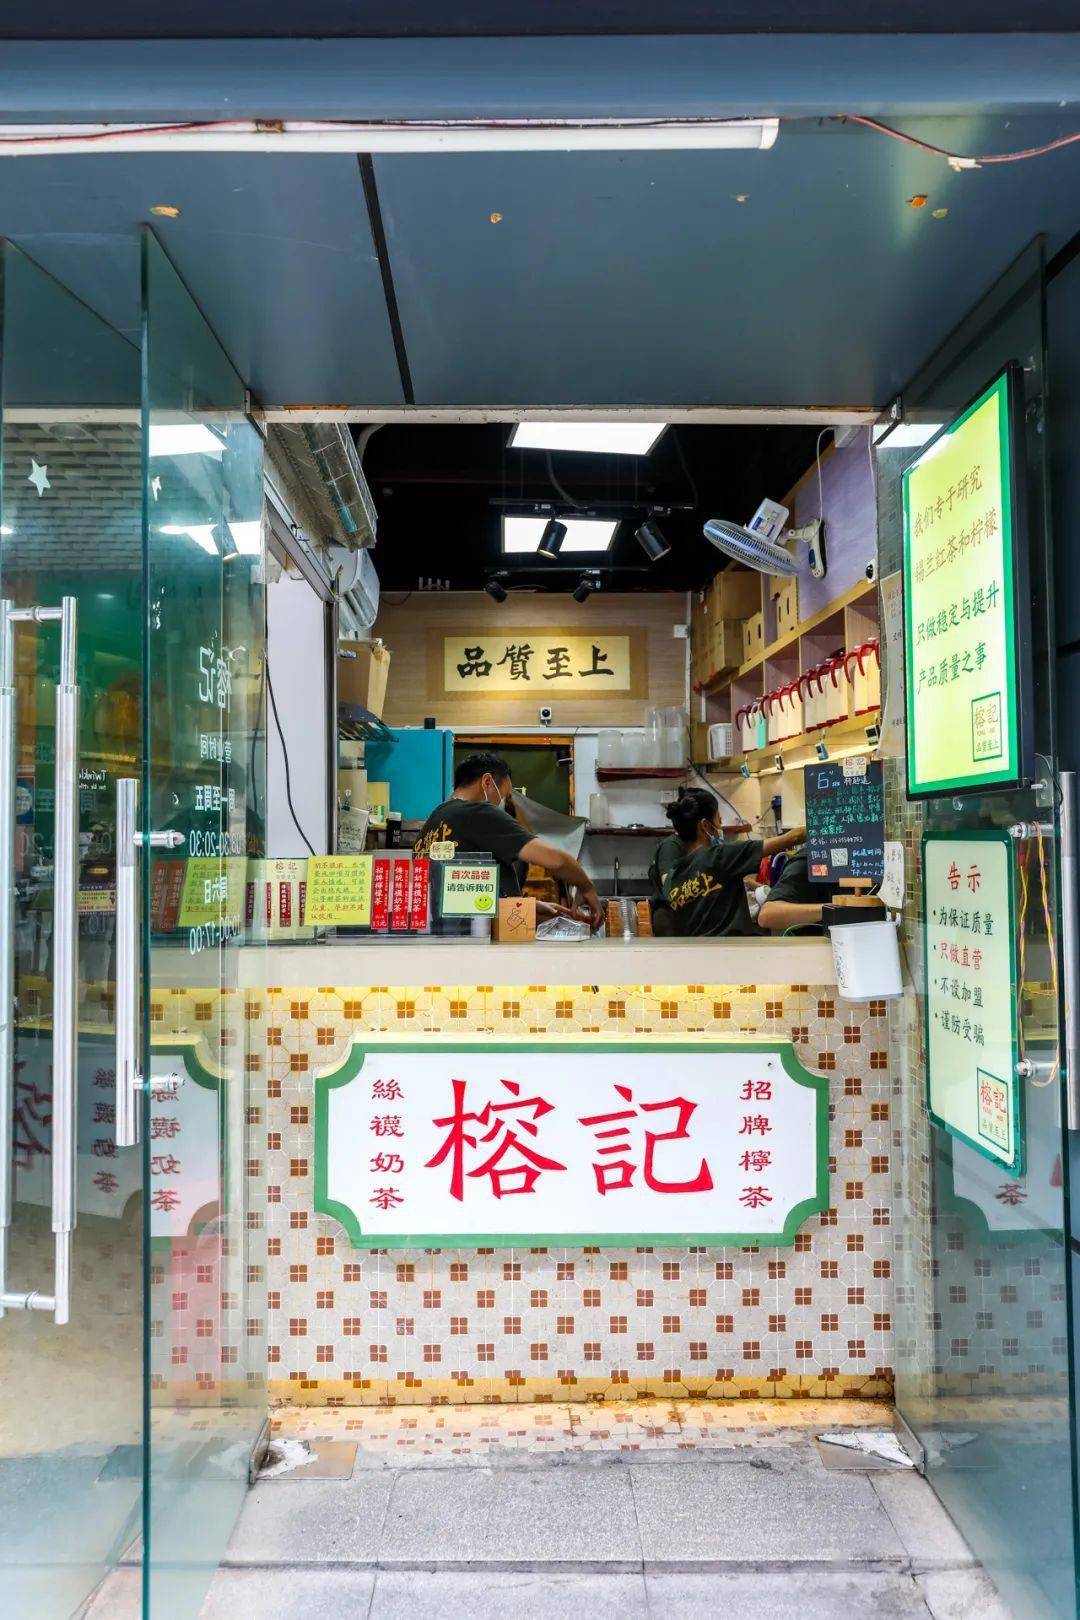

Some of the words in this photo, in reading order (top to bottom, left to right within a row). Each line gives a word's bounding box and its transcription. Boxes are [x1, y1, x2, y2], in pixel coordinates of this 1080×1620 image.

[915, 465, 982, 537] 我们专于研究
[915, 507, 998, 583] 锡兰红茶和柠檬
[917, 580, 999, 647] 只做稳定与提升
[457, 643, 614, 681] 品質至上
[917, 642, 987, 695] 产品质量之事
[976, 704, 998, 729] 榕記
[447, 883, 494, 893] 请告诉我们
[451, 870, 490, 880] 首次品尝
[947, 861, 981, 893] 告示
[939, 906, 994, 935] 为保证质量
[940, 942, 982, 970] 只做直营
[940, 977, 983, 1008] 不设加盟
[941, 1010, 984, 1047] 谨防受骗
[981, 1079, 1006, 1114] 榕記
[368, 1078, 405, 1210] 絲襪奶茶
[423, 1078, 715, 1202] 榕記
[738, 1079, 773, 1209] 招牌檸茶
